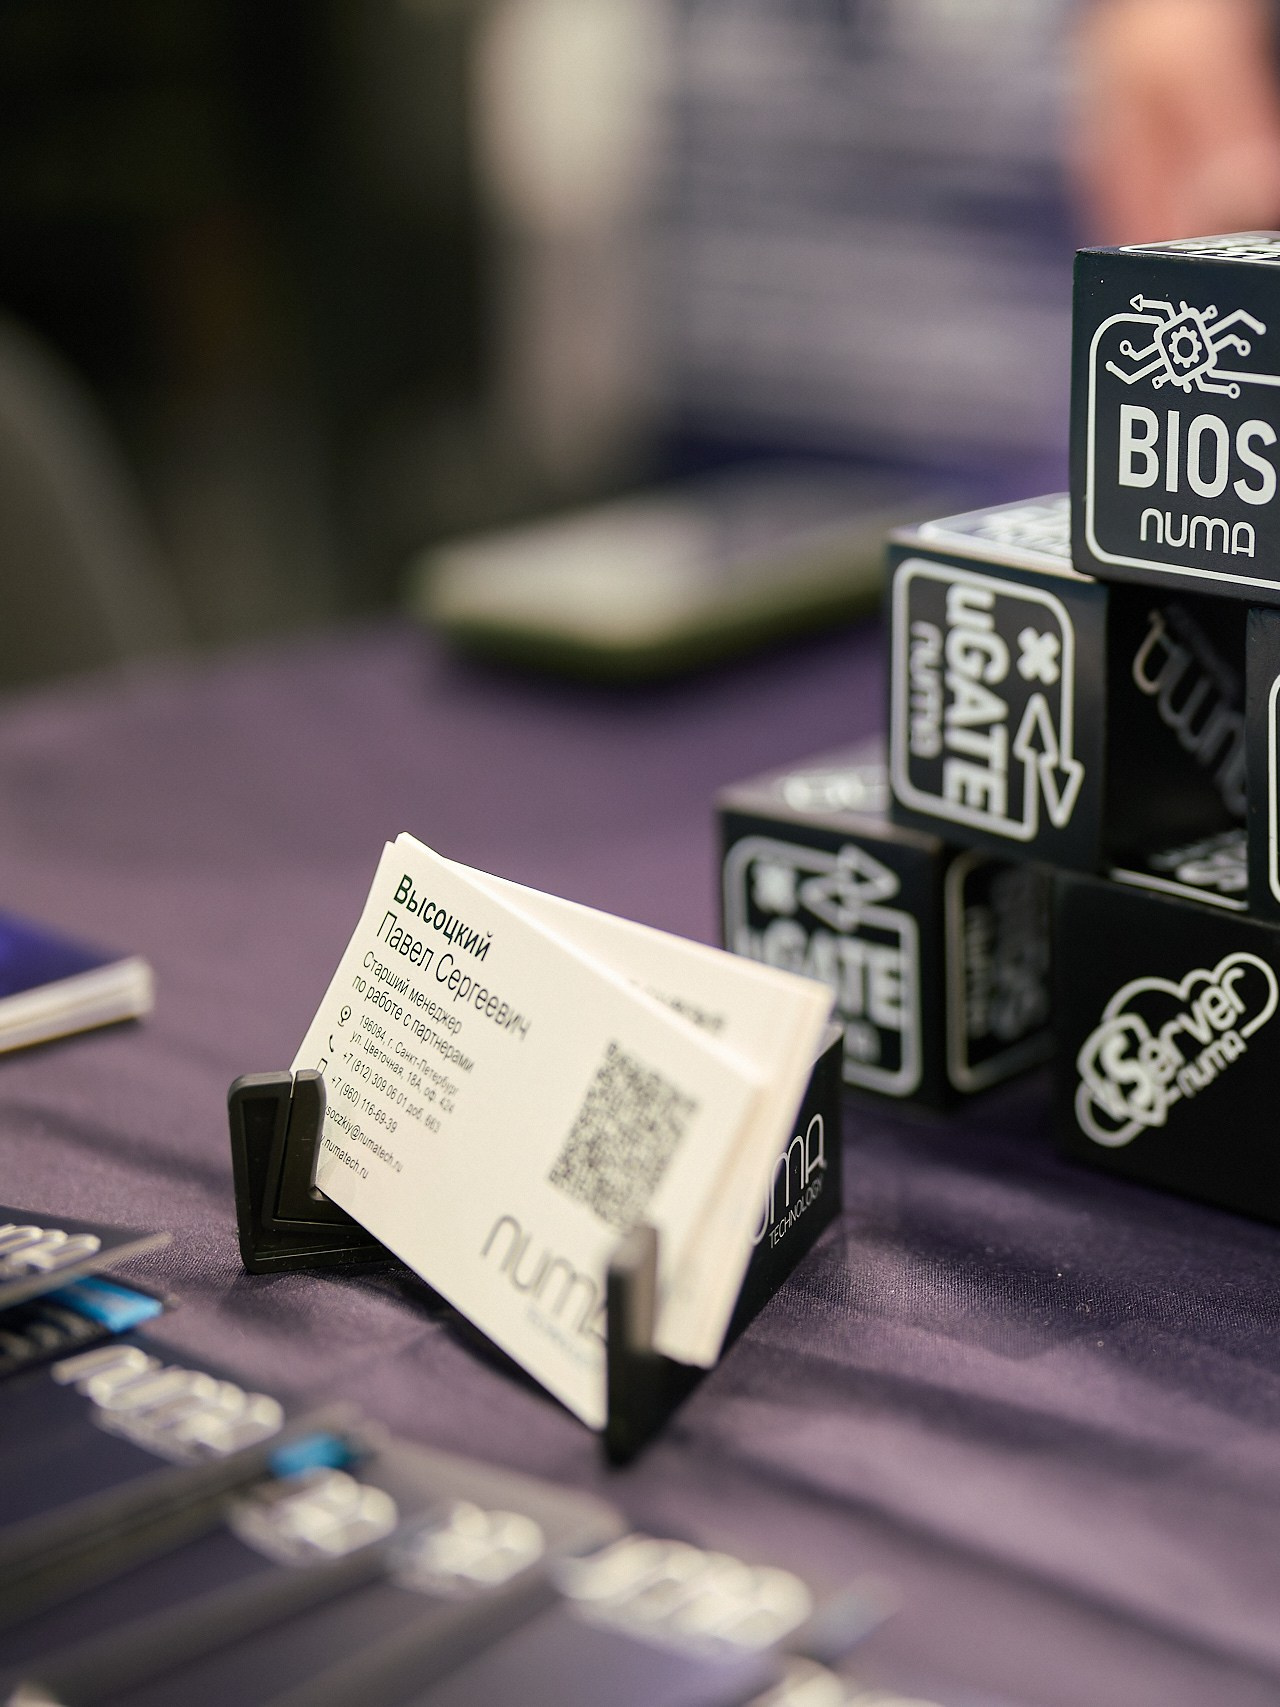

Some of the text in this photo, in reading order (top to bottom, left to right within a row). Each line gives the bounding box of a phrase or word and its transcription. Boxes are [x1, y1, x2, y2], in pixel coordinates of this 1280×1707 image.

[1118, 404, 1277, 505] BIOS
[393, 874, 493, 962] Высоцкий
[363, 951, 463, 1037] Старший менеджер
[376, 910, 532, 1041] Павел Сергеевич
[350, 1030, 362, 1047] ул.
[363, 1037, 405, 1080] Цветочная,
[352, 975, 476, 1074] по работе с партнерами
[359, 1014, 460, 1097] 196084, г. Санкт-Петербург
[331, 1075, 398, 1133] +7 (960) 116-69-39
[343, 1052, 354, 1065] +7
[350, 1058, 373, 1083] (812)
[371, 1073, 387, 1092] 309
[386, 1084, 397, 1100] 06
[396, 1092, 408, 1109] 01
[326, 1105, 404, 1173] soczkiy@numatech.ru
